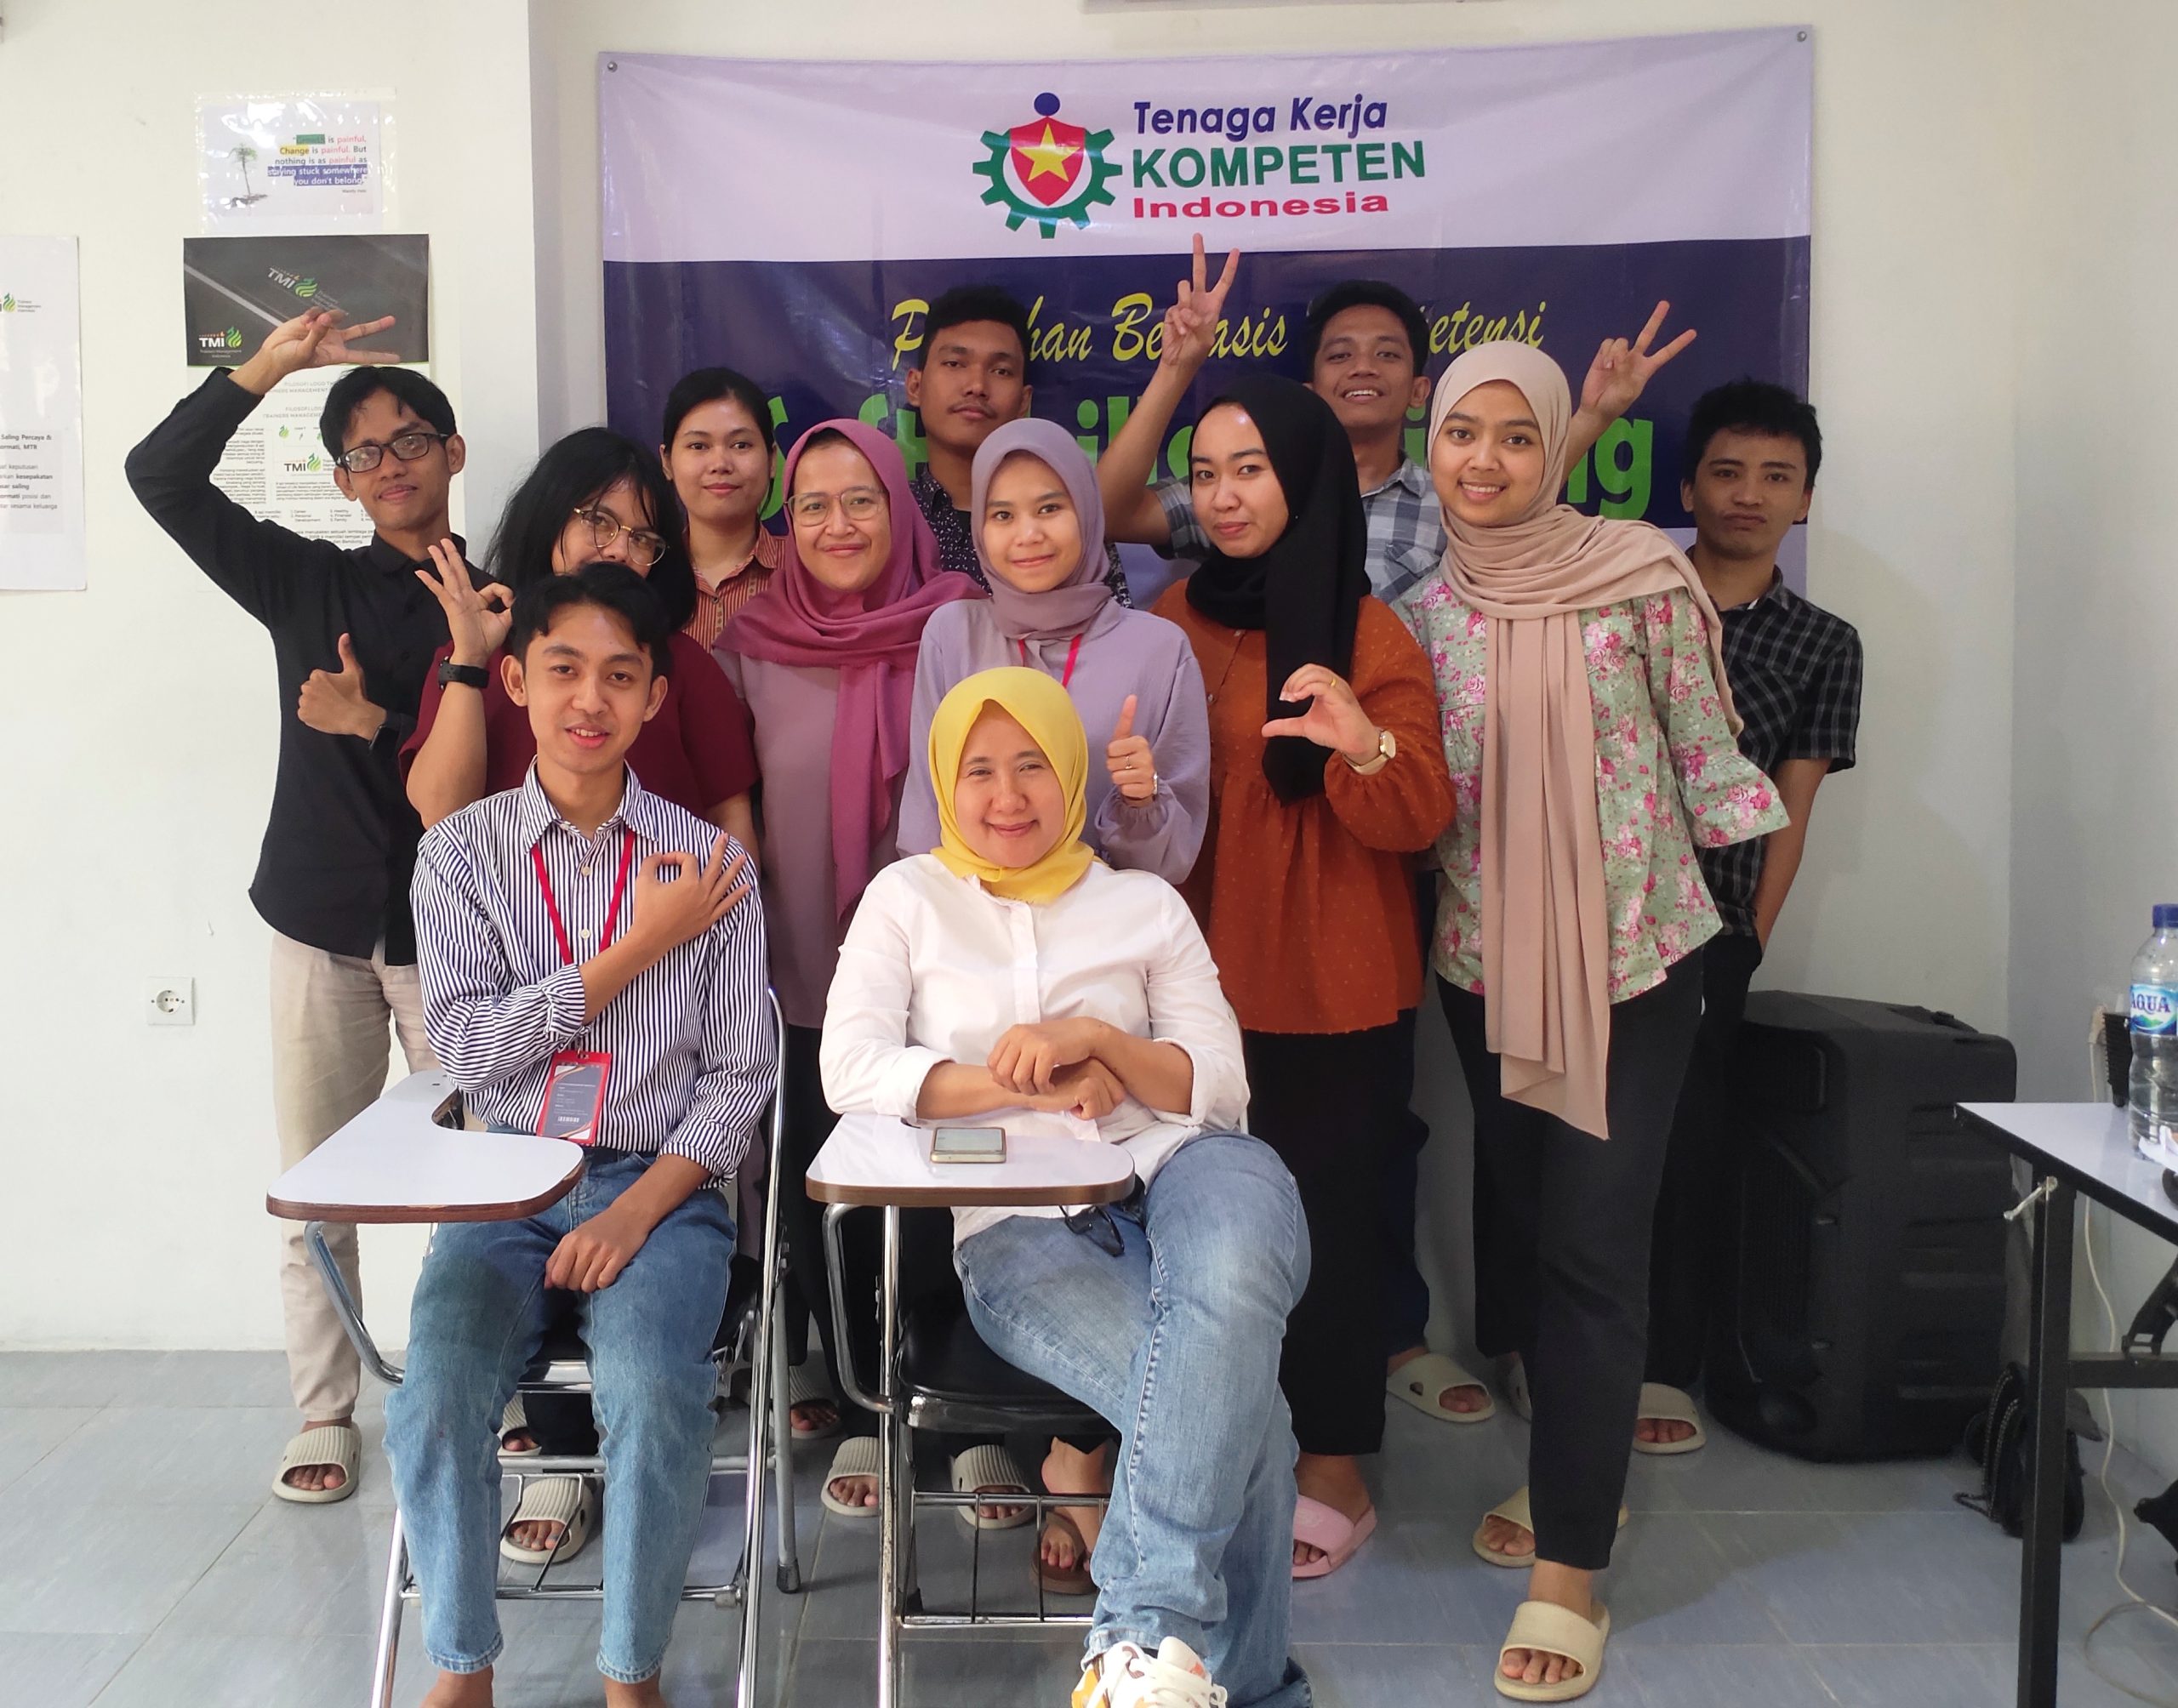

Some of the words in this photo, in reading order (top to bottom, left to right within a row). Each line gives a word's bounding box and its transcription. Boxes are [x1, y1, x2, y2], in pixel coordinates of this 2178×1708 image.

[1134, 101, 1275, 142] Tenaga
[1290, 94, 1388, 139] Kerja
[279, 146, 310, 157] Change
[299, 167, 320, 175] stuck
[1133, 140, 1426, 189] KOMPETEN
[1134, 191, 1388, 219] Indonesia
[267, 267, 296, 289] TMI
[1112, 293, 1288, 361] Beasis
[198, 337, 225, 348] TMI
[283, 463, 306, 472] TMI
